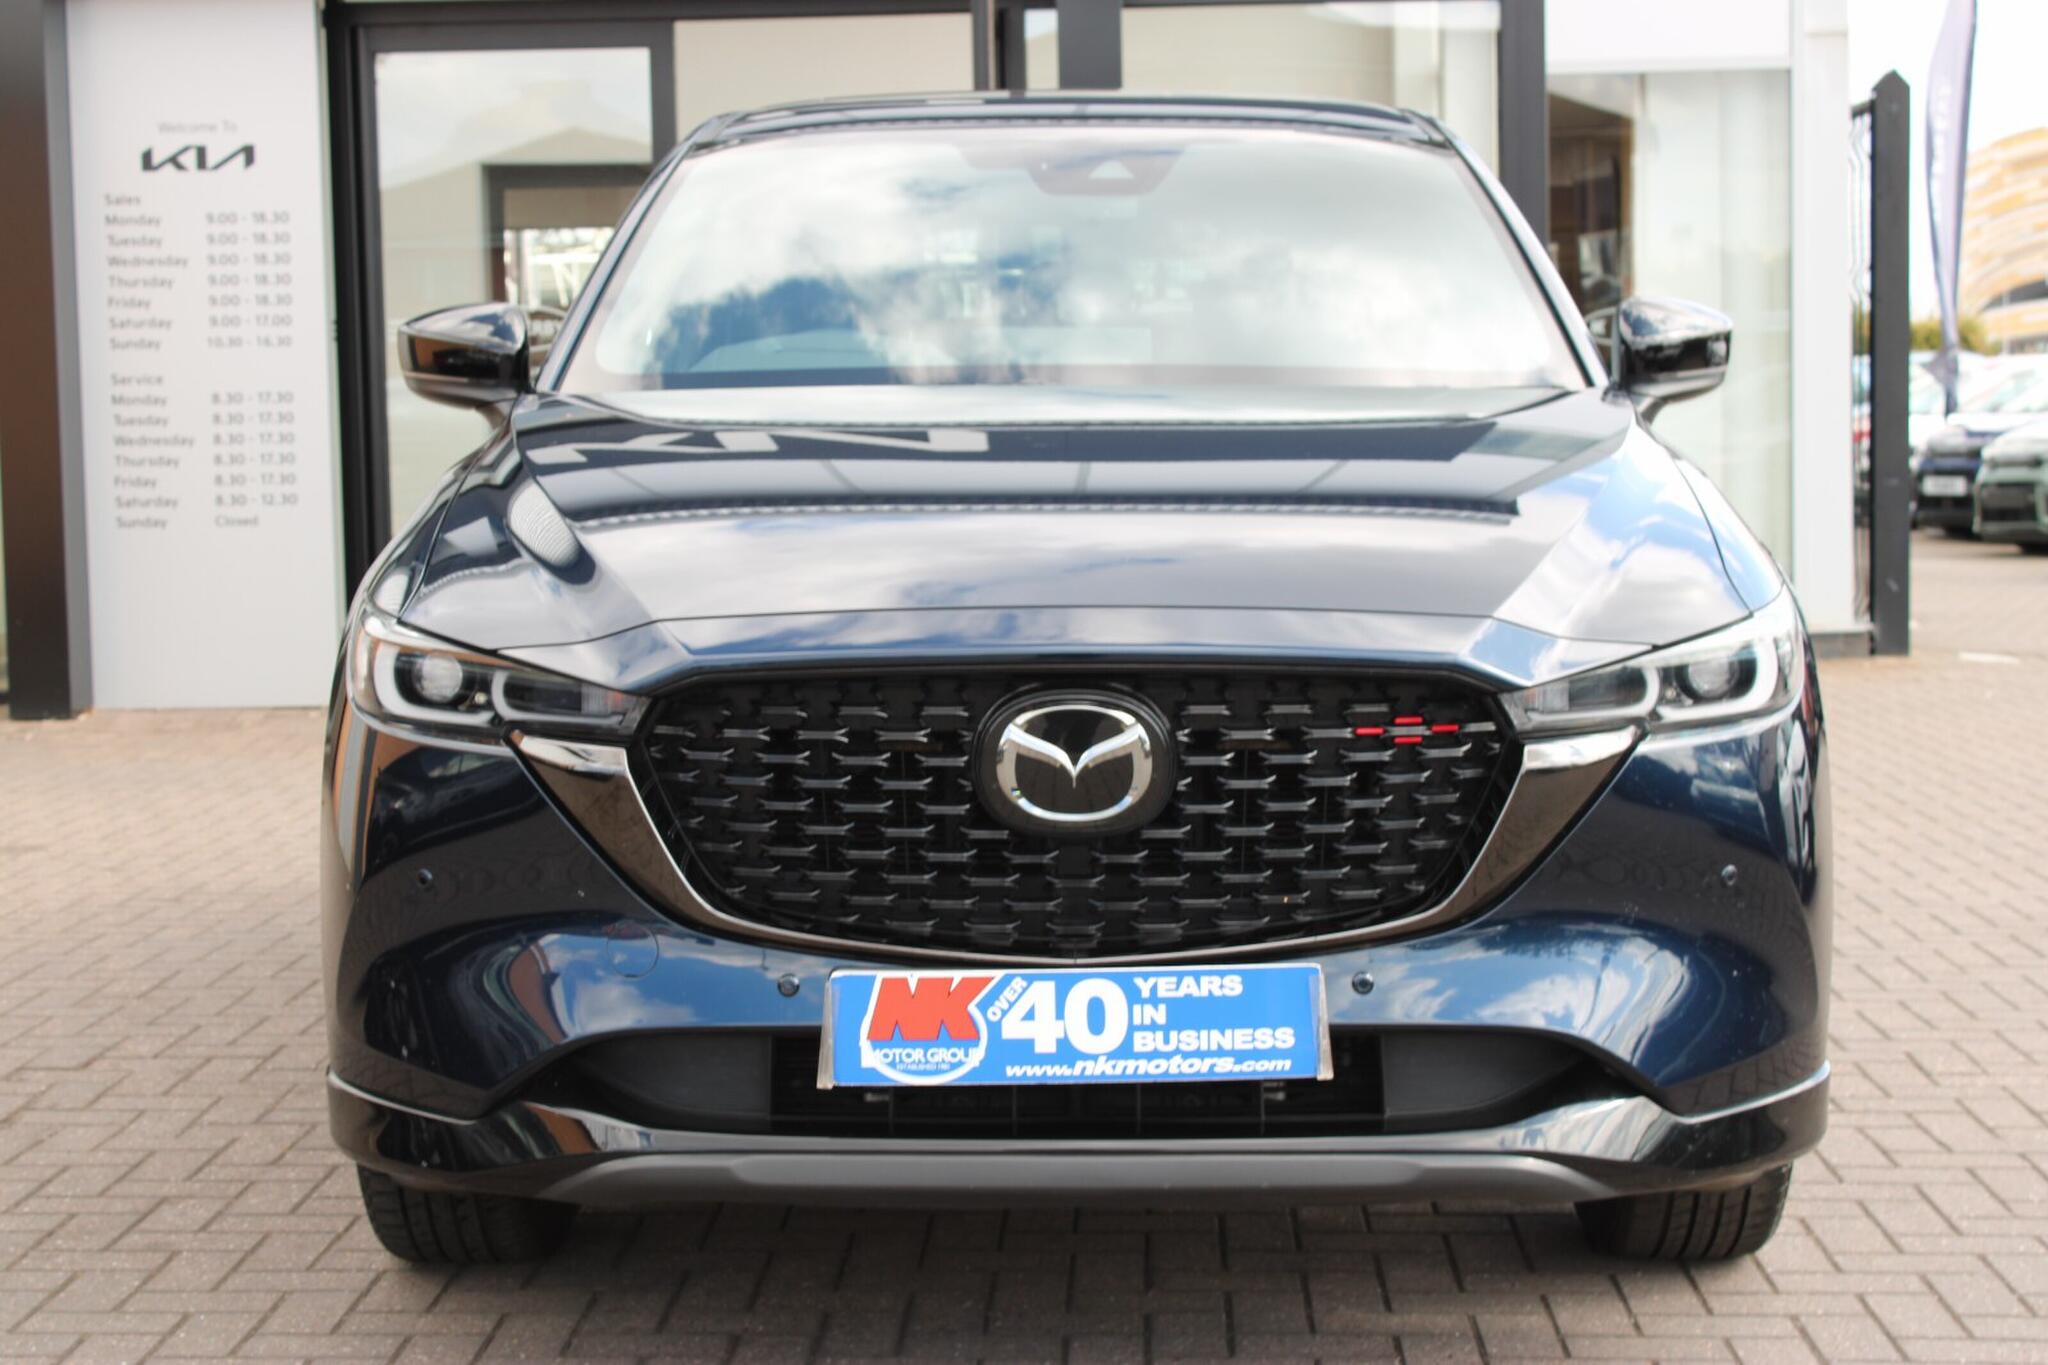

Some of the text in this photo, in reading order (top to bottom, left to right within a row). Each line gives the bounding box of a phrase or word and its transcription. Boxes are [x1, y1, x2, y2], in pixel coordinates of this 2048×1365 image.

[158, 119, 238, 133] Welcome To
[141, 145, 255, 172] KIA
[104, 193, 141, 206] Sales
[105, 214, 161, 227] Monday
[206, 212, 238, 224] 9.00
[107, 234, 162, 248] Tuesday
[206, 232, 238, 245] 9.00
[107, 255, 188, 268] Wednesday
[207, 253, 239, 266] 9.00
[108, 275, 174, 290] Thursday
[208, 274, 240, 286] 9.00
[107, 296, 150, 310] Friday
[208, 294, 240, 306] 9.00
[109, 317, 172, 331] Saturday
[209, 315, 241, 328] 9.00
[110, 337, 161, 351] Sunday
[111, 373, 163, 386] Service
[111, 394, 167, 407] Monday
[113, 414, 168, 427] Tuesday
[113, 435, 194, 448] Wednesday
[114, 454, 179, 469] Thursday
[114, 475, 157, 488] Friday
[115, 495, 178, 509] Saturday
[116, 515, 259, 530] Sunday Closed
[1133, 975, 1243, 998] YEARS
[987, 976, 1028, 1022] OVER
[867, 976, 995, 1041] NK
[1132, 1004, 1167, 1026] IN
[1001, 978, 1129, 1055] 40
[1133, 1027, 1296, 1053] BUSINESS
[1005, 1054, 1292, 1077] www.nkmotors.com
